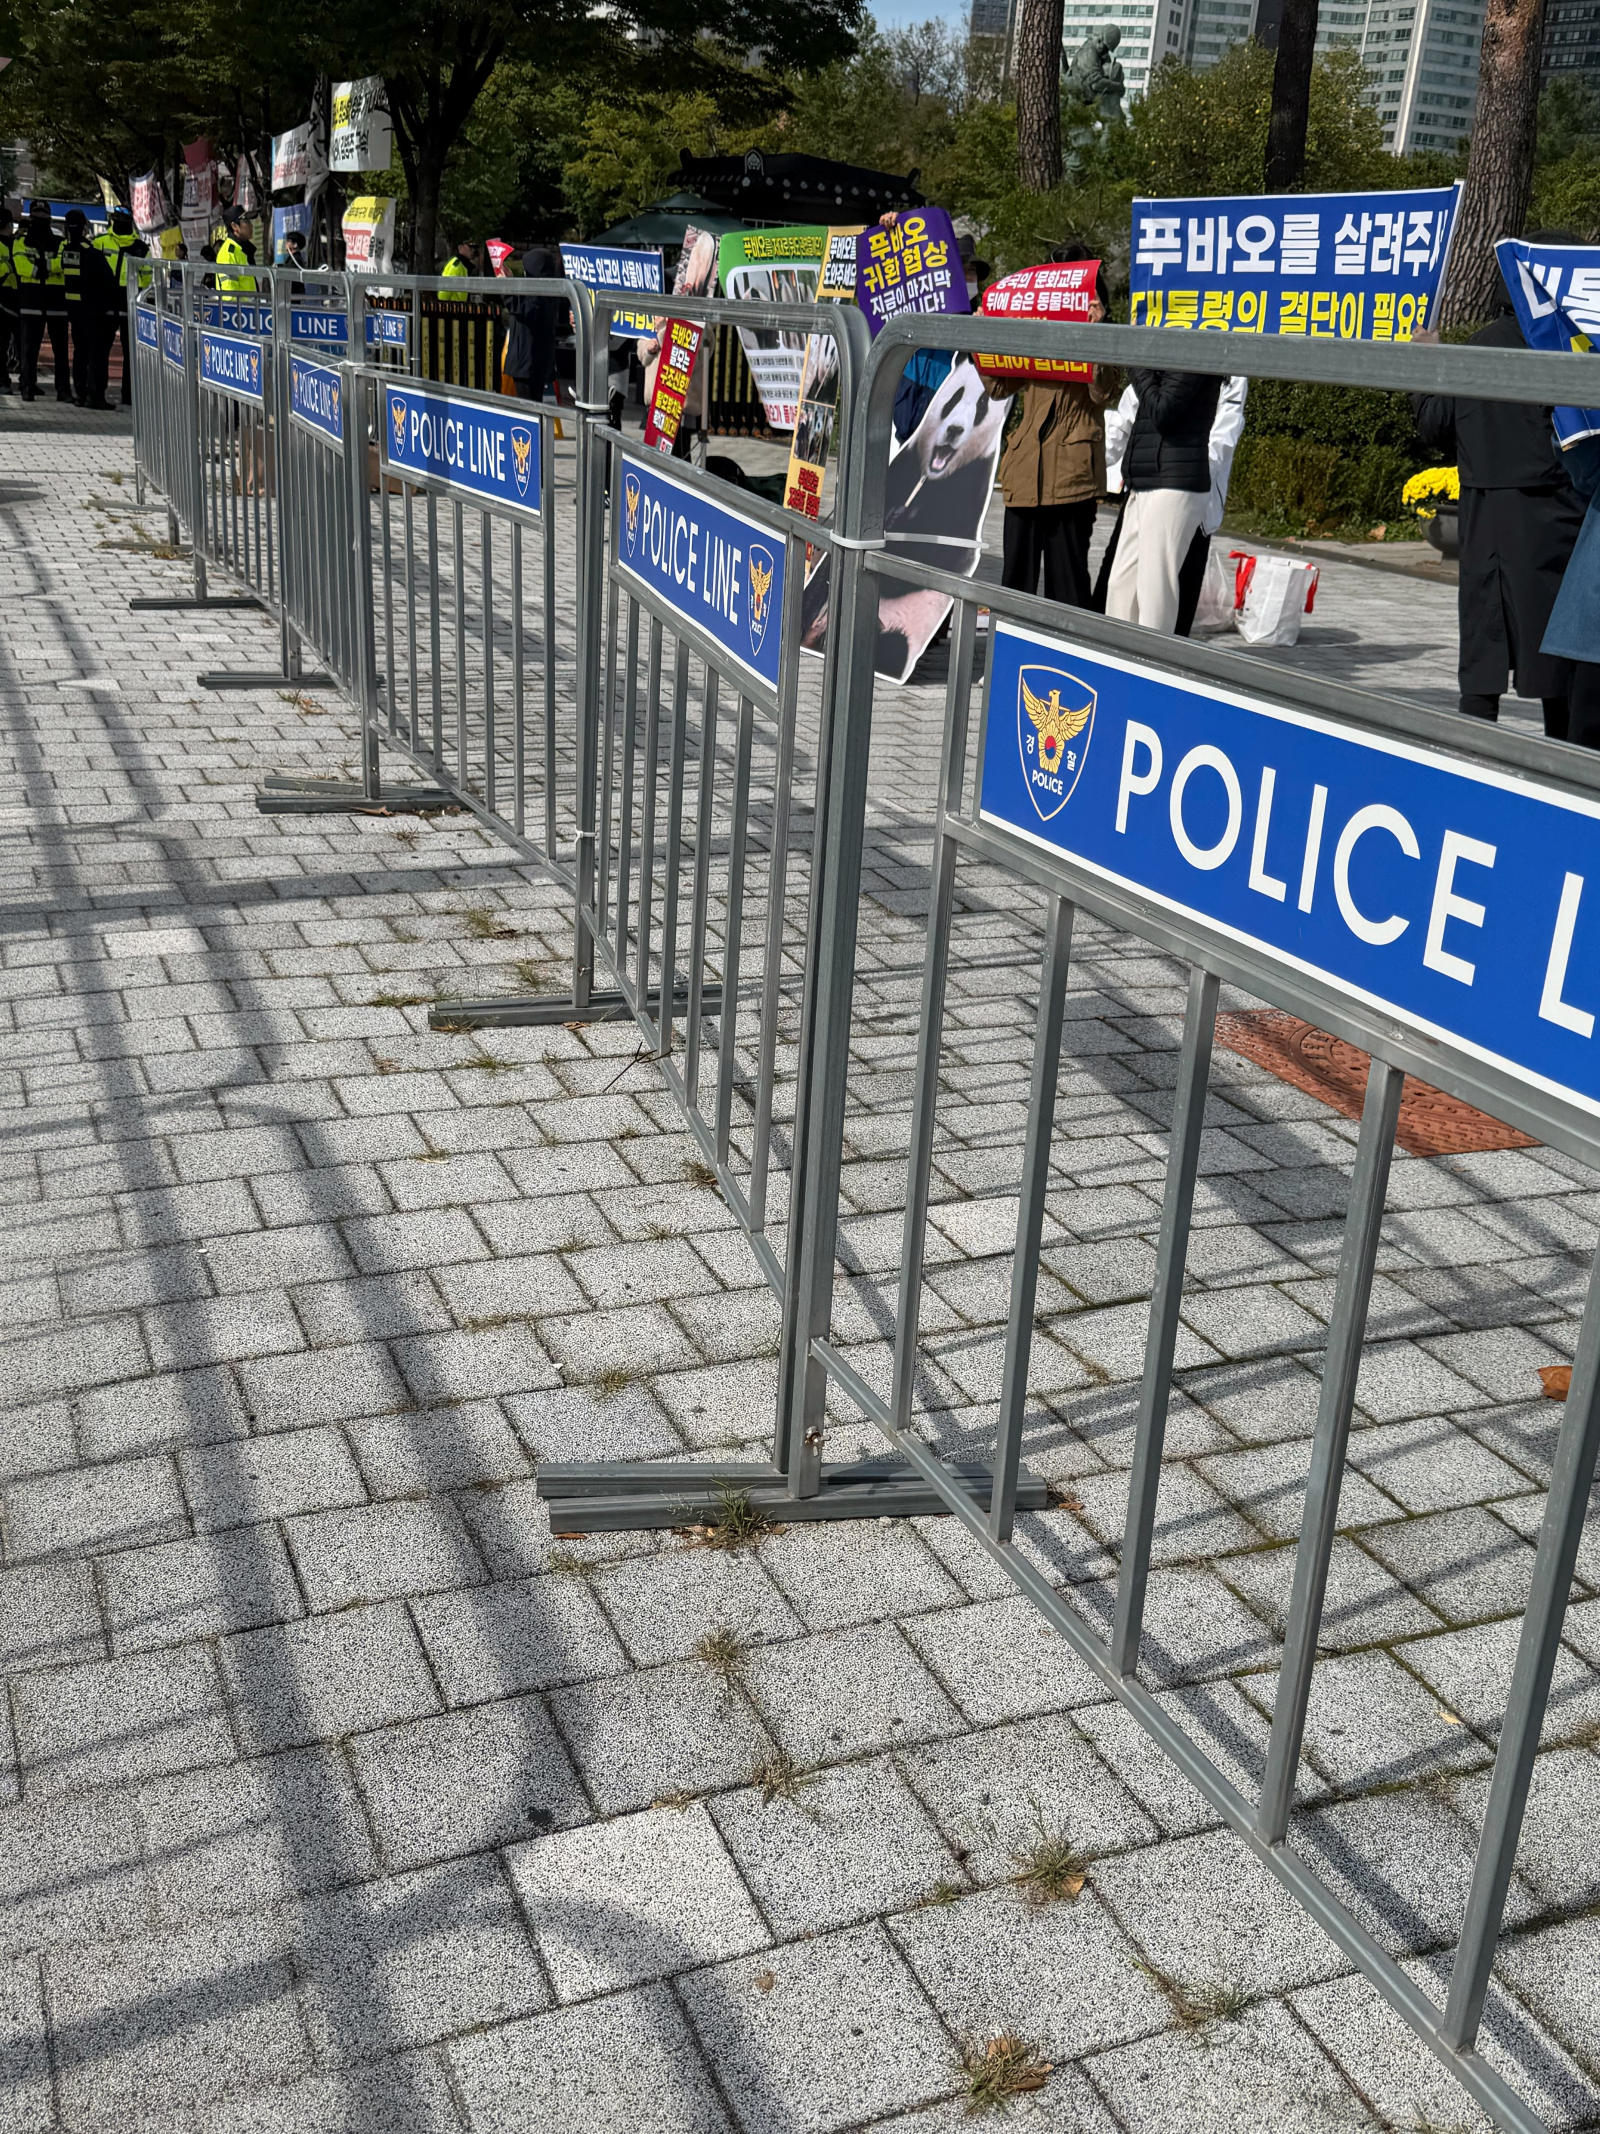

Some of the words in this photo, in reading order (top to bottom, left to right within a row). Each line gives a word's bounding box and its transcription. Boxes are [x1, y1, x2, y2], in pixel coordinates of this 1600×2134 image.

[742, 235, 773, 260] 푸바오를
[829, 235, 857, 260] 푸바오를
[868, 216, 929, 261] 푸바오
[1135, 213, 1321, 276] 푸바오를
[562, 254, 597, 283] 푸바오는
[595, 258, 622, 285] 외교의
[863, 255, 902, 294] 귀환
[901, 240, 949, 277] 협상
[996, 270, 1034, 290] 중국의
[869, 285, 907, 316] 지금이
[906, 269, 951, 299] 마지막
[986, 292, 1010, 311] 뒤에
[1010, 291, 1036, 311] 숨은
[1036, 291, 1089, 312] 동물학대
[221, 311, 272, 332] POLIC
[298, 316, 338, 336] LINE
[1130, 290, 1268, 334] 대통령의
[1279, 290, 1364, 340] 결단이
[670, 322, 700, 353] 푸바오의
[211, 345, 234, 378] POLICE
[234, 351, 249, 383] LINE
[669, 344, 691, 373] 탈모는
[411, 409, 464, 468] POLICE
[469, 424, 506, 481] LINE
[642, 494, 699, 593] POLICE
[703, 530, 742, 626] LINE
[1031, 769, 1064, 796] POLICE
[1115, 719, 1498, 987] POLICE
